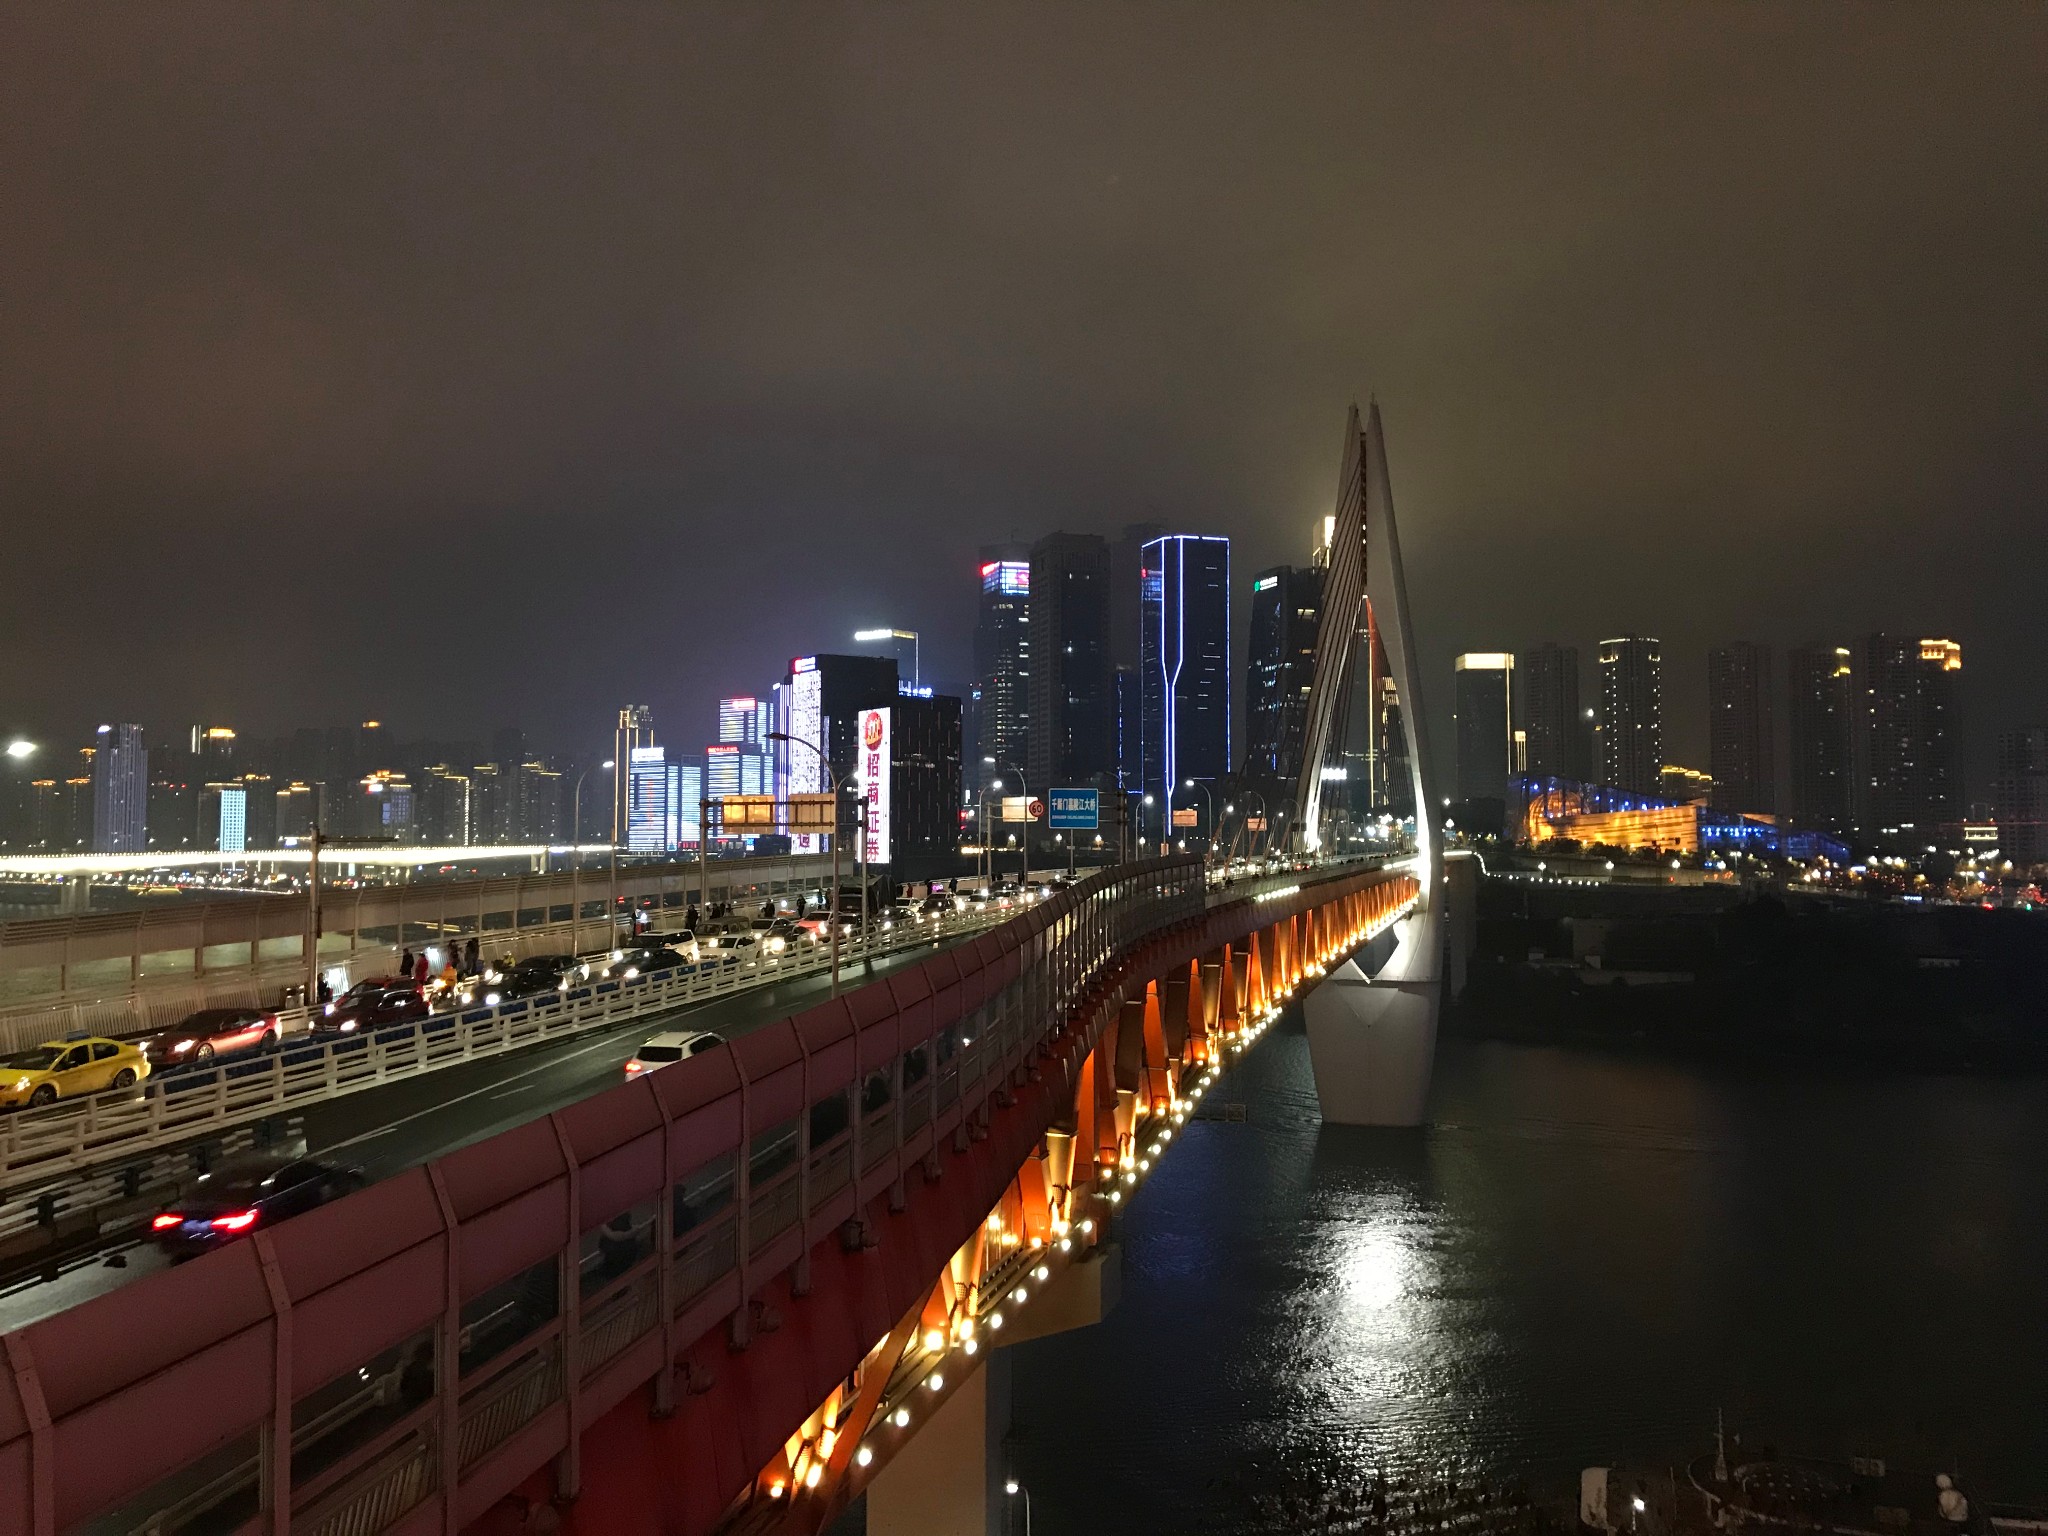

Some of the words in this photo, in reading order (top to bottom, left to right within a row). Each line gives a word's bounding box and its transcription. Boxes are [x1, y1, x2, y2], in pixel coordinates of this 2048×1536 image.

[866, 753, 880, 862] 招商证券
[1031, 804, 1042, 813] 60
